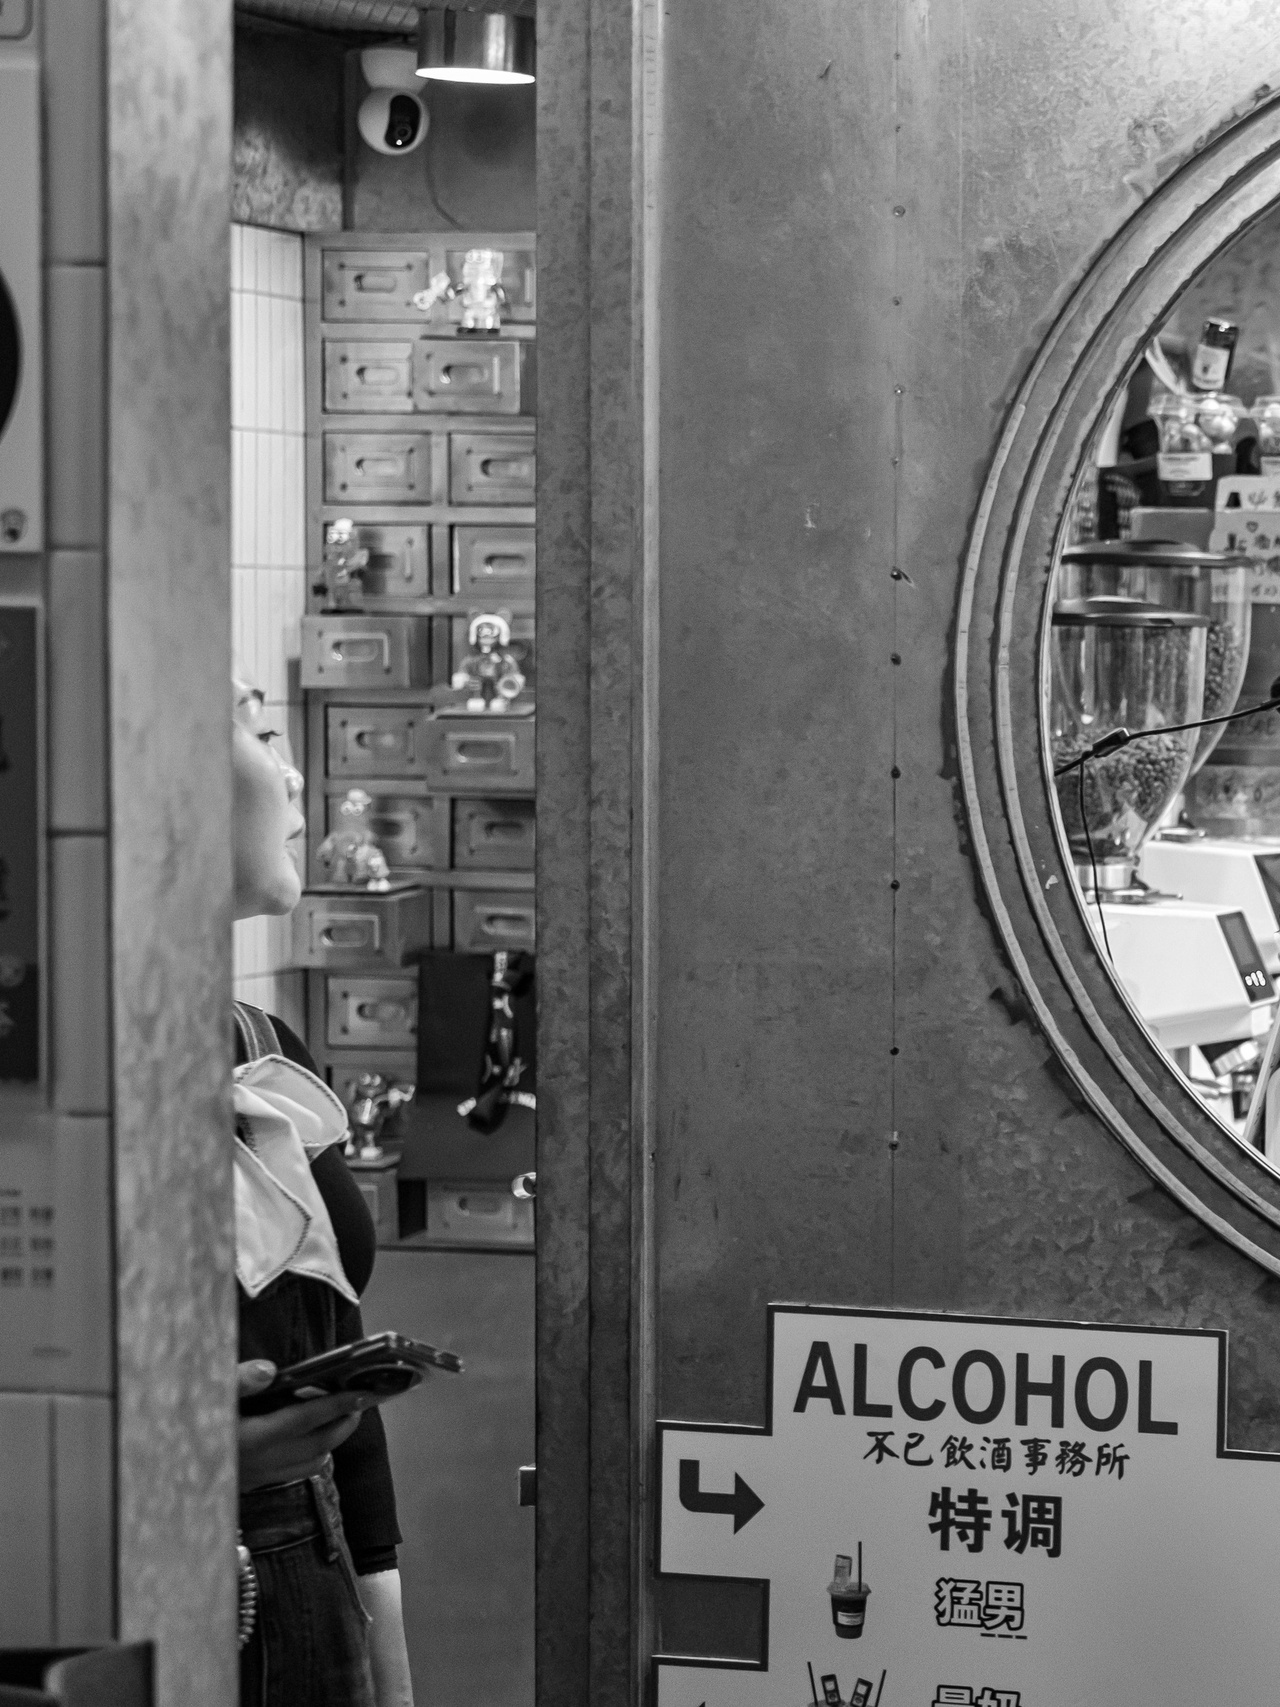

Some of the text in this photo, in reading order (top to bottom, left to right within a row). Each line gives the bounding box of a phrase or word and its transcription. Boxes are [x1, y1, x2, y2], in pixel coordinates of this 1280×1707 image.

[793, 1341, 1179, 1436] ALCOHOL
[928, 1486, 1063, 1559] 特调
[933, 1576, 1025, 1632] 猛男
